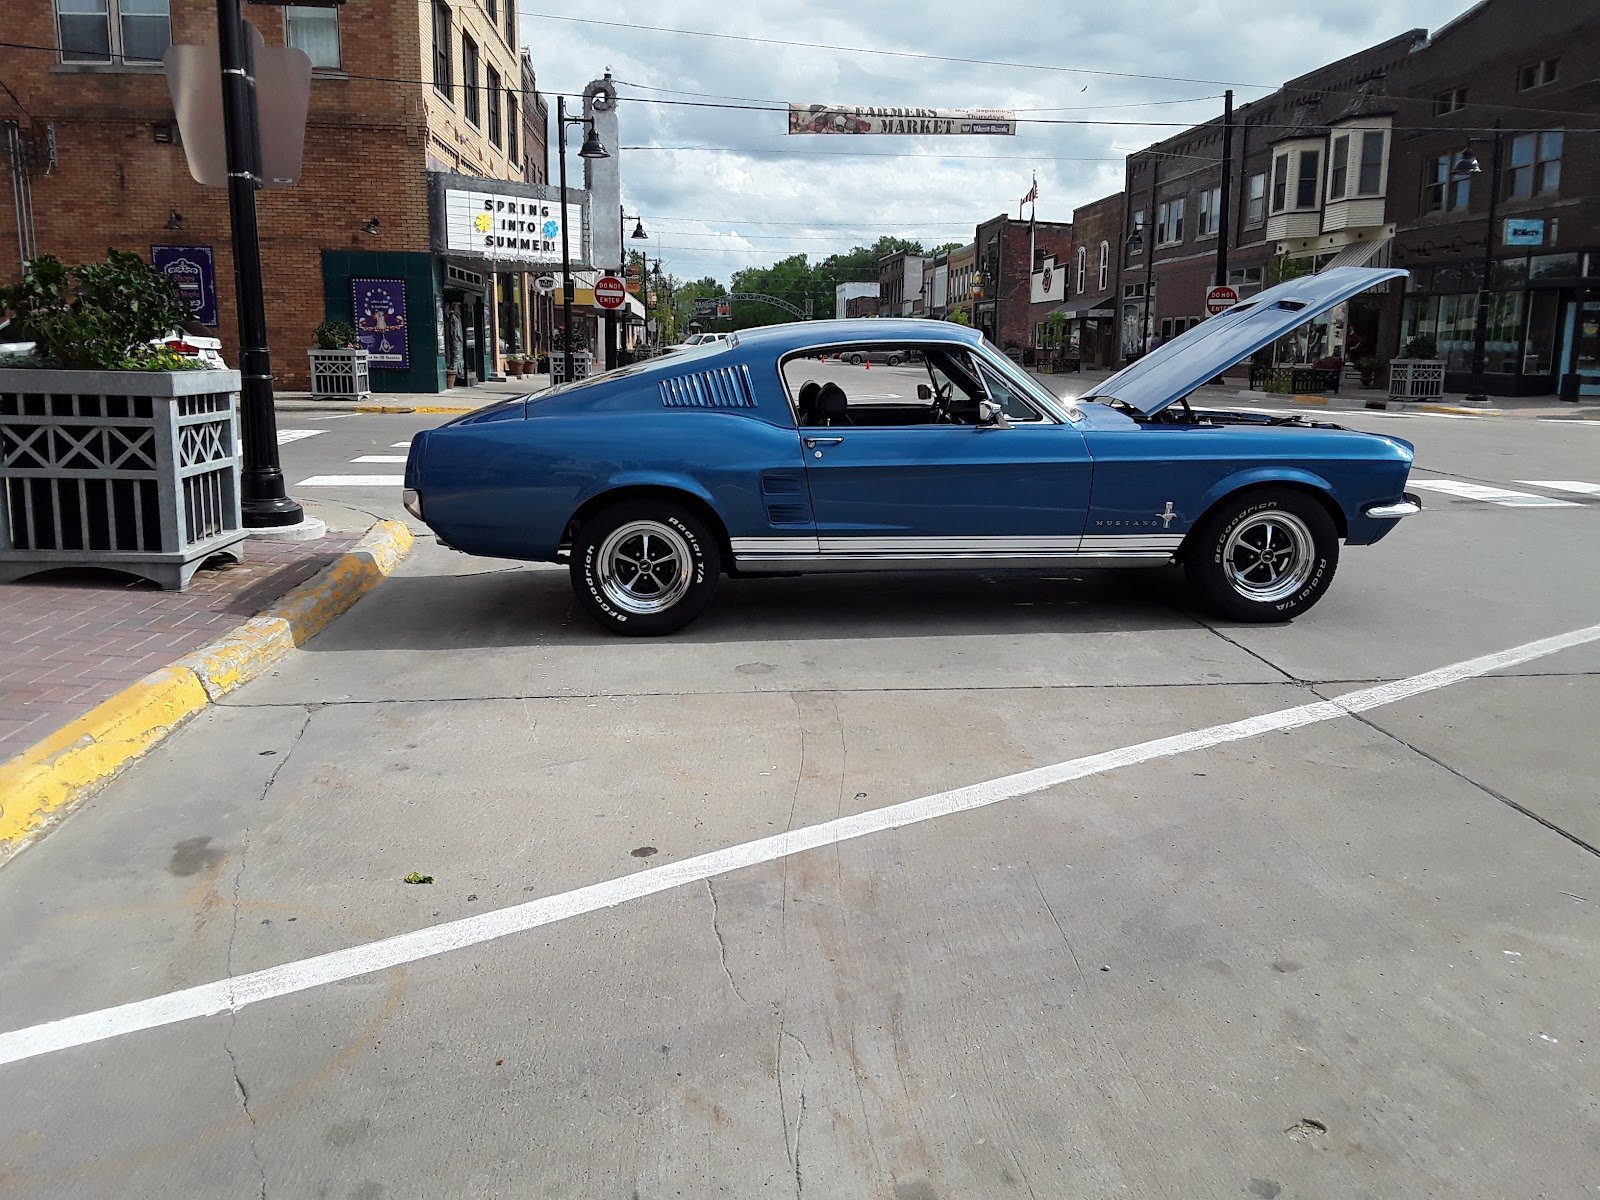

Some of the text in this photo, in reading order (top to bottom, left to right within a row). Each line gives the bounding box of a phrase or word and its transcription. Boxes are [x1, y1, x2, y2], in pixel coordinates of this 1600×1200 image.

[855, 106, 938, 117] FARMERS
[880, 119, 955, 134] MARKET
[484, 199, 549, 217] SPRING
[502, 219, 536, 233] INTO
[485, 235, 556, 252] SUMMER!
[600, 296, 620, 304] ENTER
[1214, 501, 1277, 563] BFGoodrich
[667, 516, 705, 584] Radial T/A
[584, 545, 628, 622] BFGoodrich
[1276, 558, 1327, 611] Radial T/A
